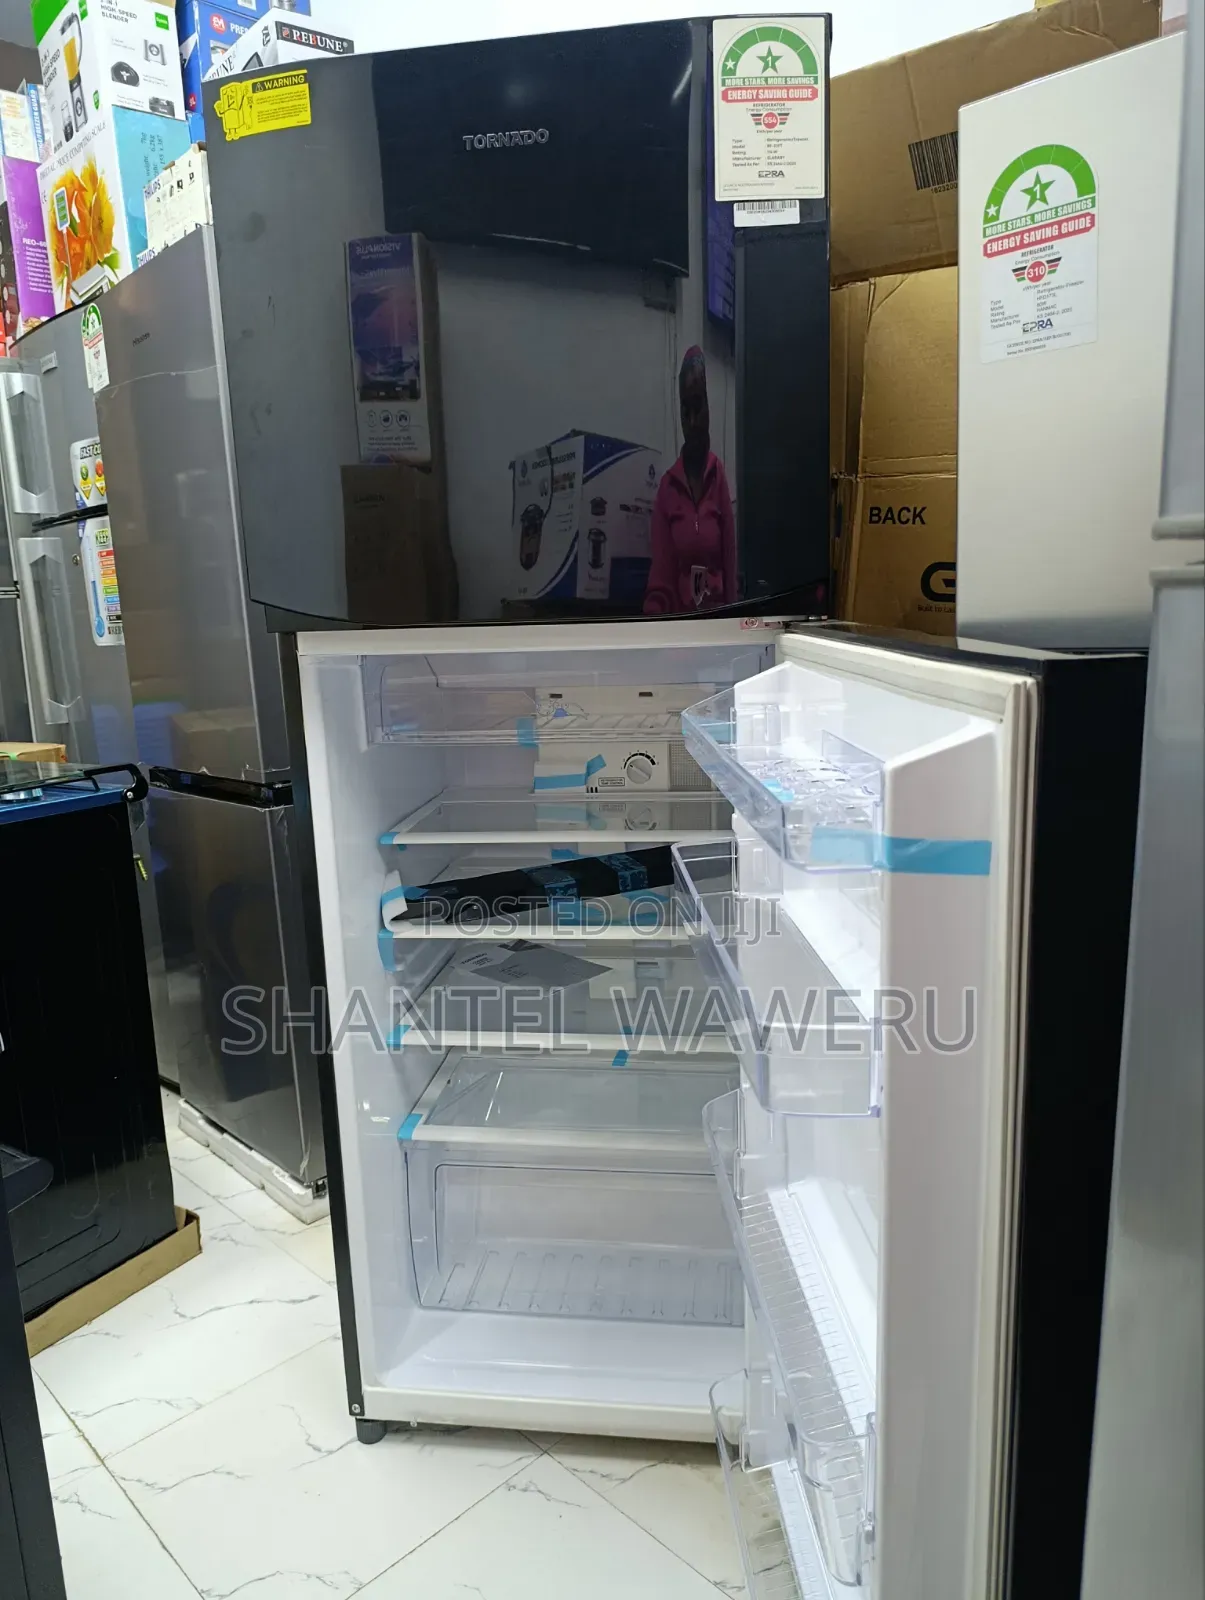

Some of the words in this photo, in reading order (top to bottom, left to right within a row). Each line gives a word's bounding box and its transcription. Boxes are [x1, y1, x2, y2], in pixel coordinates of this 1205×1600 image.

[292, 28, 344, 52] REBUNE
[208, 55, 235, 79] UNE
[766, 57, 773, 68] 1
[263, 75, 305, 90] WARNING
[725, 78, 744, 86] MORE
[744, 78, 767, 86] STARS,
[767, 77, 786, 85] MORE
[786, 76, 815, 84] SAVINGS
[727, 90, 757, 100] ENERGY
[758, 89, 788, 99] SAVING
[788, 88, 813, 98] GUIDE
[463, 128, 550, 151] TORNADO
[758, 169, 786, 178] EPRA
[1033, 184, 1041, 200] 1
[985, 222, 1007, 237] MORE
[1007, 216, 1033, 231] STARS,
[1034, 210, 1057, 224] MORE
[1057, 198, 1093, 216] SAVINGS
[986, 234, 1021, 254] ENERGY
[1023, 224, 1059, 244] SAVING
[1061, 216, 1092, 234] GUIDE
[1027, 265, 1046, 278] 310
[990, 299, 1002, 307] Type
[1022, 318, 1054, 333] EPRA
[868, 506, 928, 525] BACK
